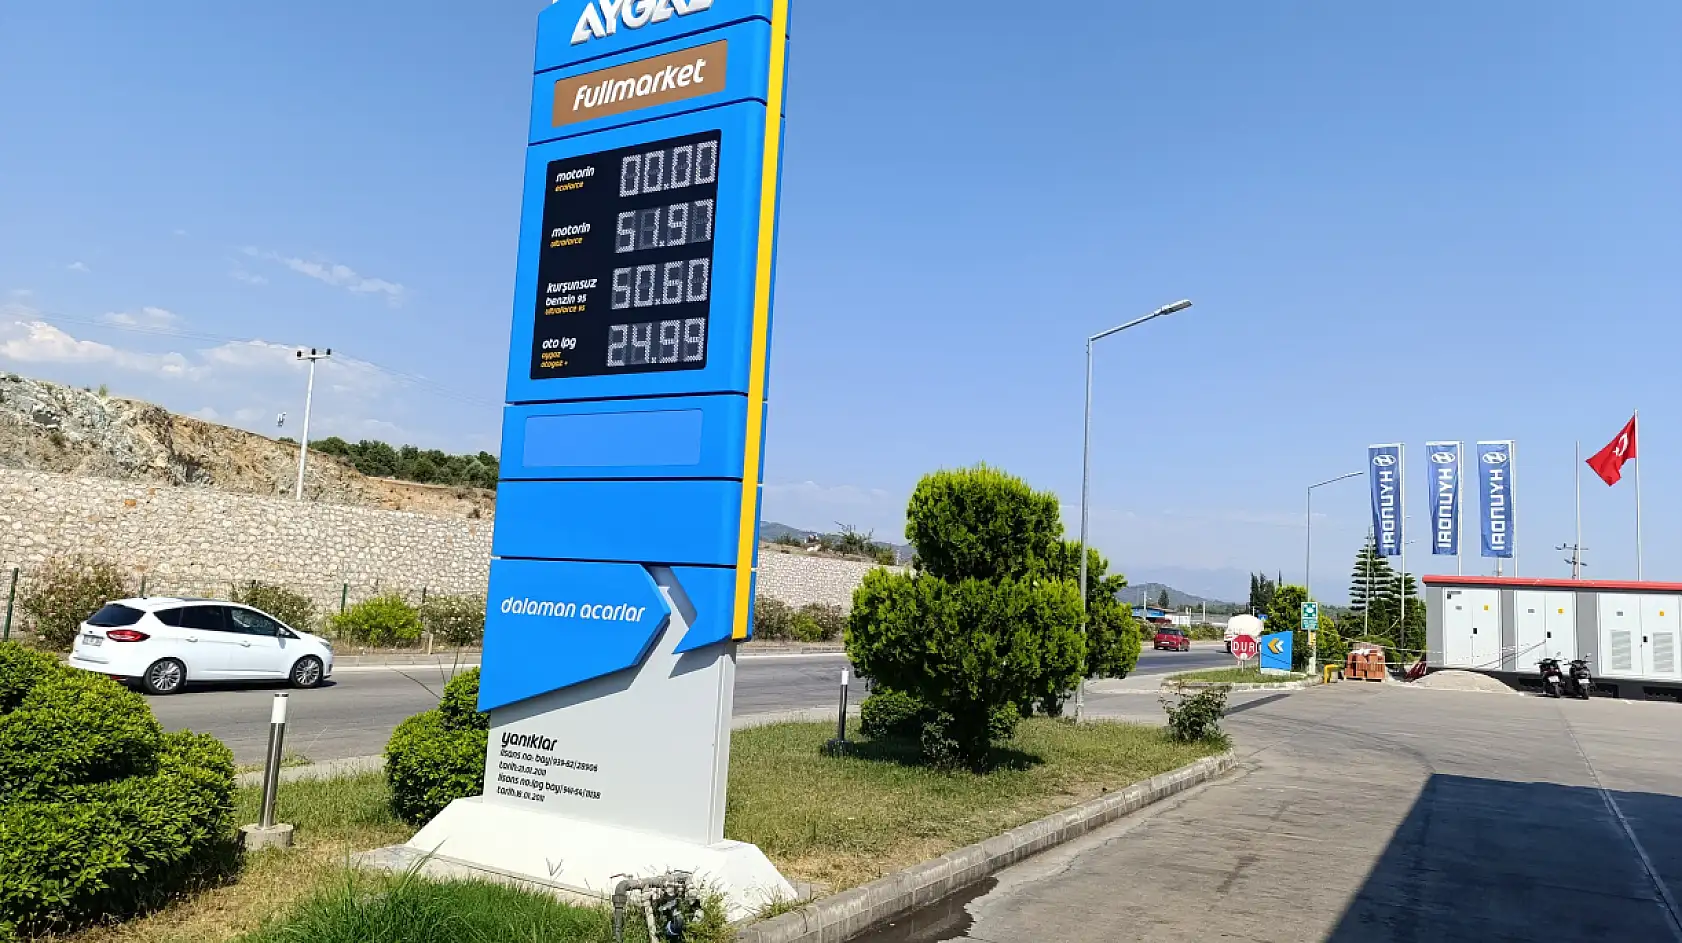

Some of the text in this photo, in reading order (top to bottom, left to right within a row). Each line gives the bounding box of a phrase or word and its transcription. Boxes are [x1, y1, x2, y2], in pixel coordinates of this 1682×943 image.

[555, 165, 595, 183] motorin
[619, 139, 719, 198] 00.00
[551, 222, 591, 239] motorin
[614, 198, 714, 254] 51.97
[546, 278, 598, 294] kurşunsuz
[611, 257, 710, 310] 50.60
[545, 293, 576, 306] benzin
[542, 336, 577, 350] oto lpg
[606, 317, 706, 367] 24.99
[501, 596, 646, 622] dalaman acarlar
[1233, 641, 1255, 653] DUR
